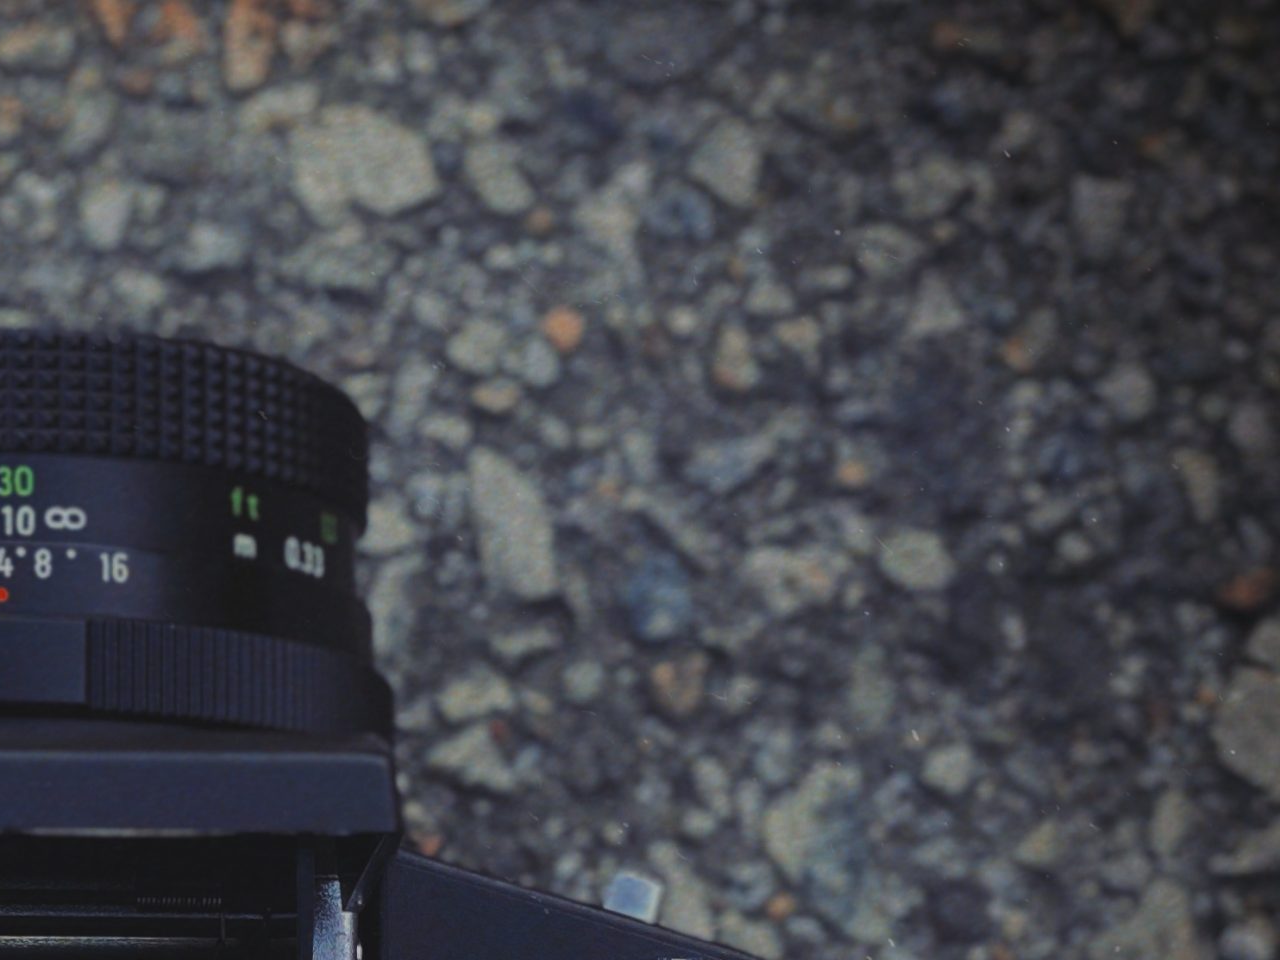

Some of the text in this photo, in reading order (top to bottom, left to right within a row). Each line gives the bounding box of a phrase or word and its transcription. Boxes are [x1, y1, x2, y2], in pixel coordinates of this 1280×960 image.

[1, 505, 36, 536] 10
[33, 549, 53, 579] 8
[99, 552, 129, 583] 16
